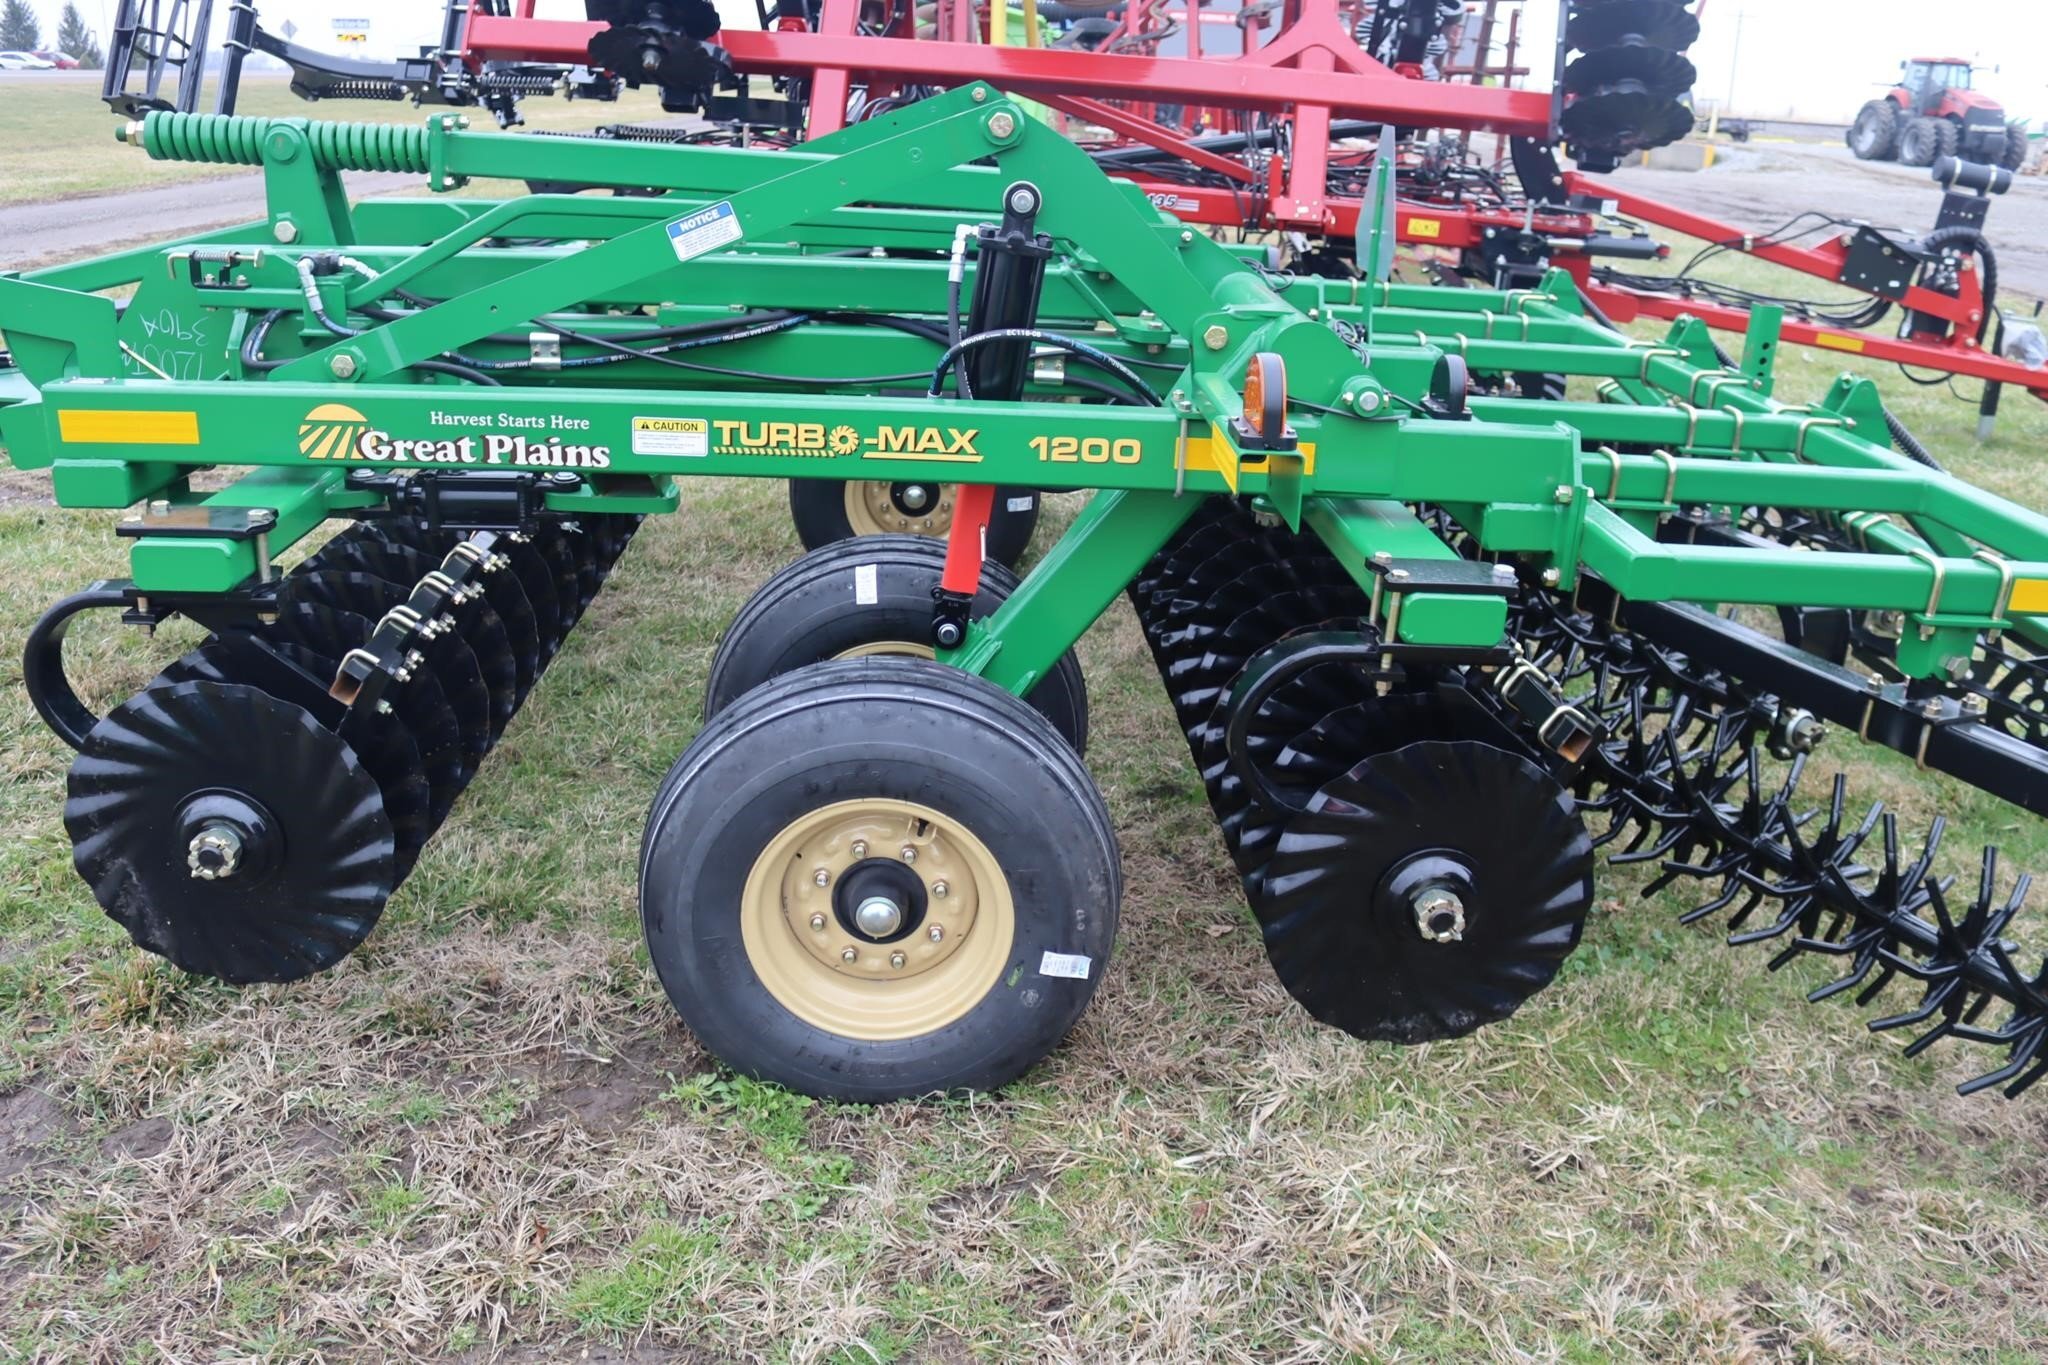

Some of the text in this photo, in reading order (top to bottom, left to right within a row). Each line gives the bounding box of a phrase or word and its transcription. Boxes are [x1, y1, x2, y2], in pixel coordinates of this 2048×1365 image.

[679, 209, 720, 232] NOTICE
[430, 410, 590, 430] Harvest Starts Here
[653, 421, 698, 431] CAUTION
[358, 430, 477, 462] Great
[483, 433, 610, 468] Plains
[1028, 436, 1142, 464] 1200
